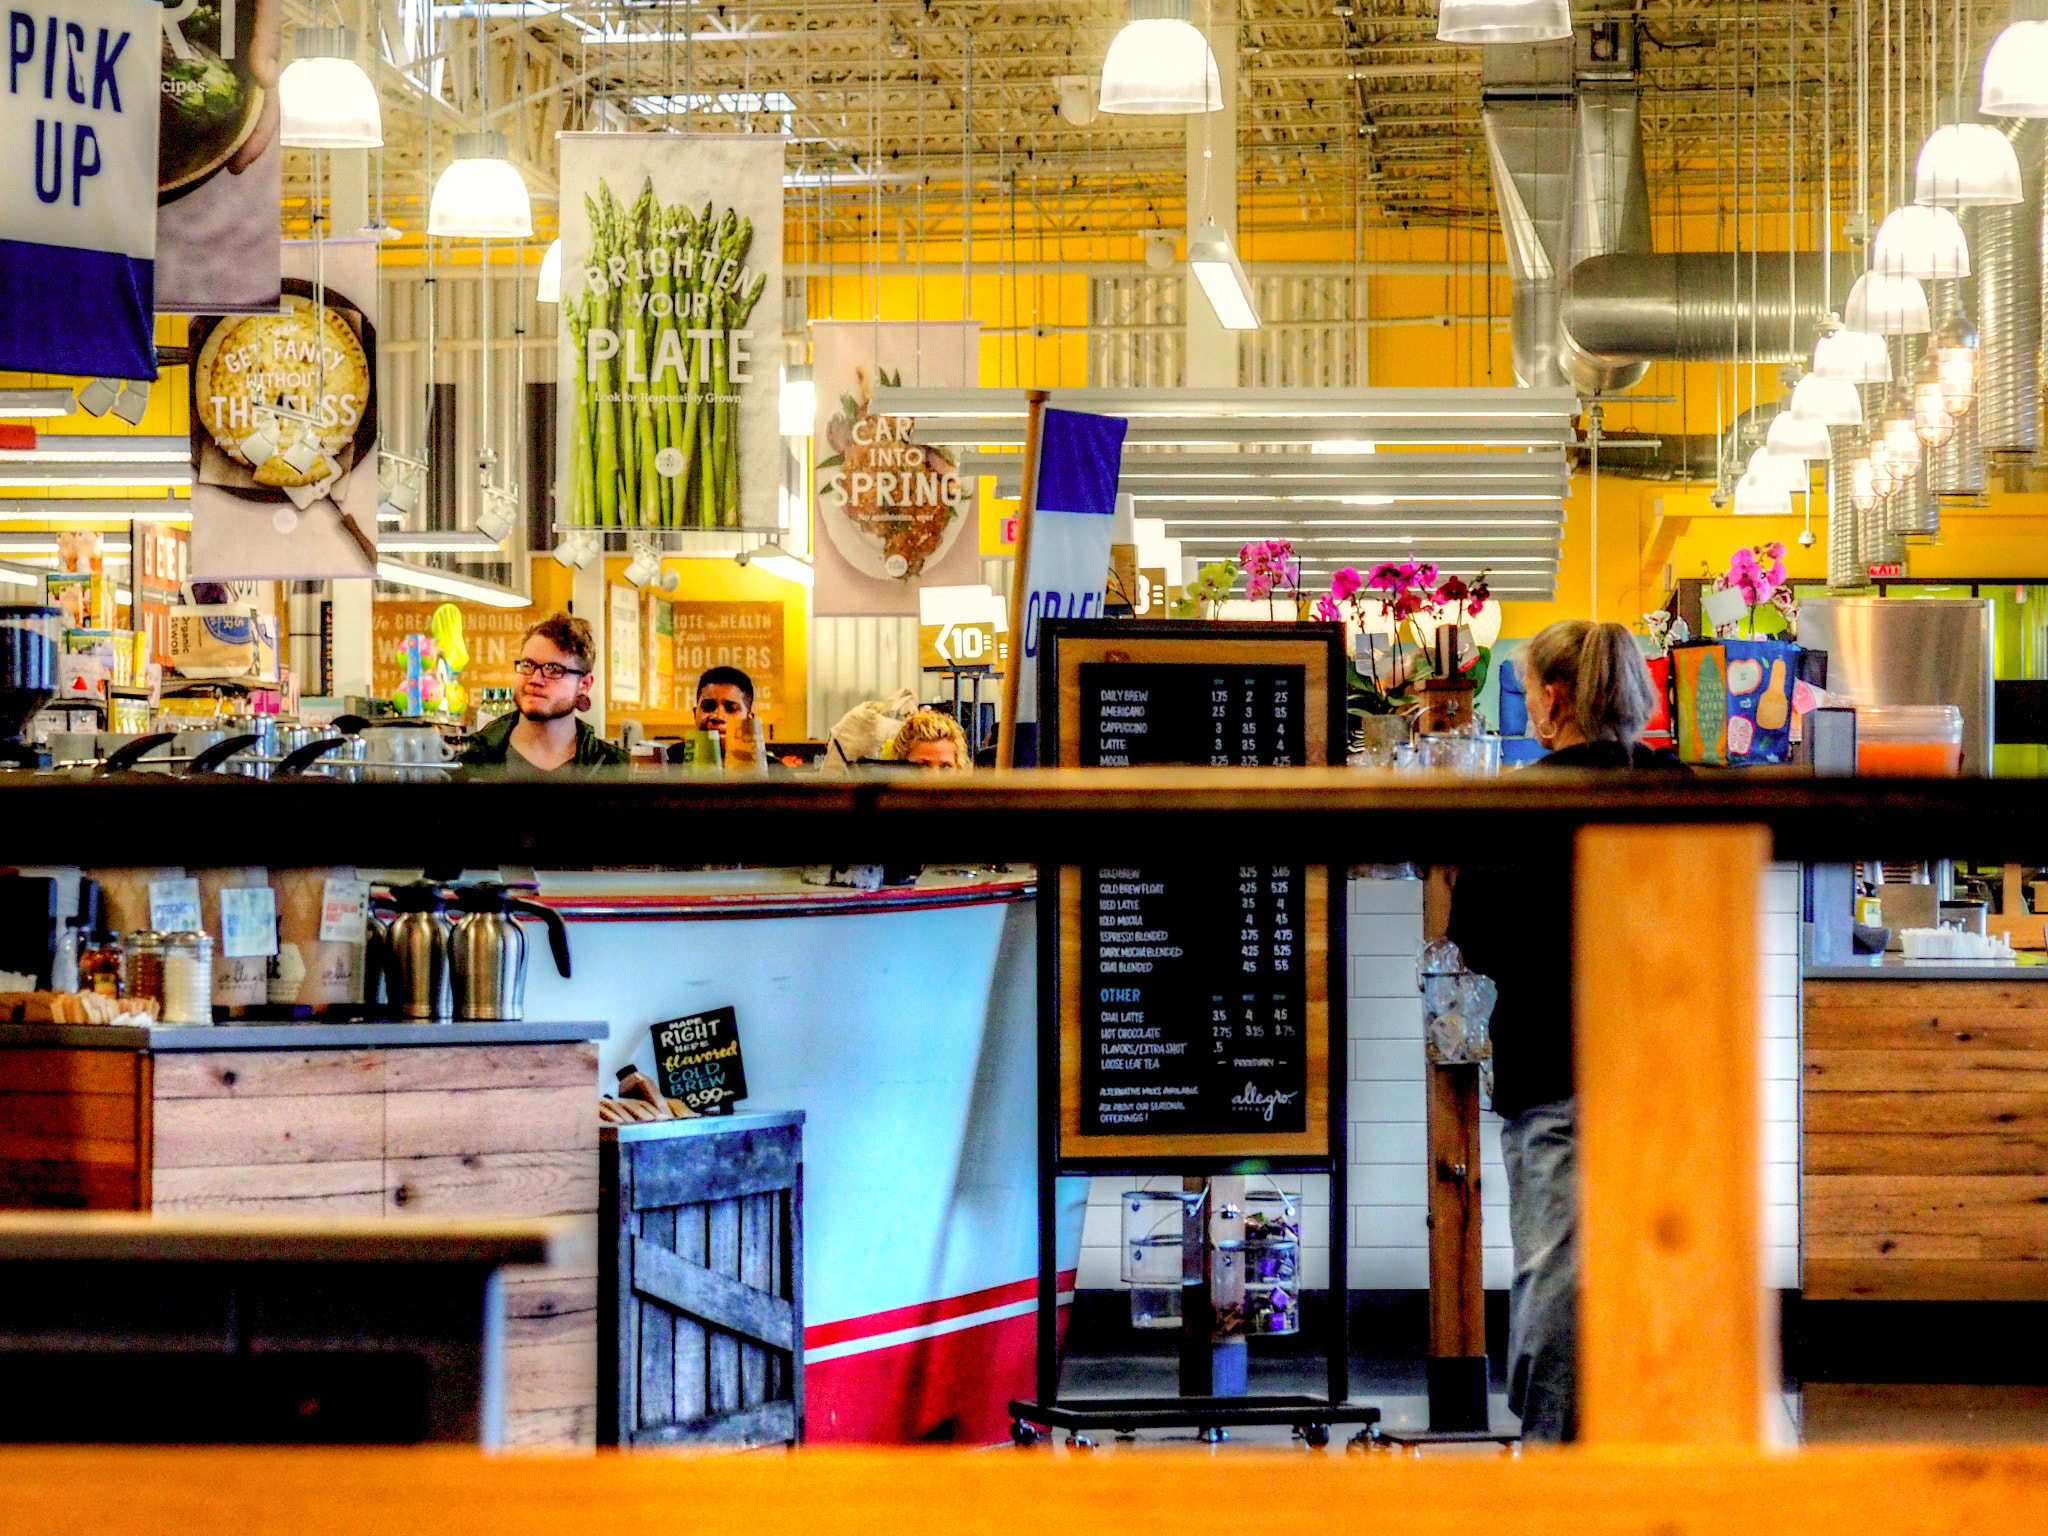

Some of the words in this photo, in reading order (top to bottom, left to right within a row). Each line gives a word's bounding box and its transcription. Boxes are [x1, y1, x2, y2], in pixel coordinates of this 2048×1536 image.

[10, 10, 130, 113] PICK
[161, 77, 210, 97] cipes.
[35, 119, 101, 206] UP
[584, 247, 757, 298] BRIGHTEN
[636, 292, 709, 319] YOUR
[224, 341, 262, 374] GET
[273, 338, 346, 371] FANCY
[587, 328, 754, 384] PLATE
[595, 392, 621, 403] Look
[623, 391, 638, 402] for
[640, 392, 703, 404] Responsibly
[210, 396, 266, 429] THE
[851, 417, 914, 446] CAR
[869, 448, 924, 467] INTO
[829, 471, 962, 508] SPRING
[395, 613, 434, 631] CREA
[720, 614, 772, 630] HEALTH
[1245, 690, 1253, 702] 2
[1101, 706, 1145, 717] AMERICANO
[1245, 706, 1253, 718] 3
[1215, 722, 1222, 734] 3
[1276, 723, 1285, 735] 4
[1101, 738, 1127, 750] LATTE
[1215, 738, 1222, 750] 3
[1276, 739, 1285, 751] 4
[1117, 899, 1140, 910] LATTE
[1276, 898, 1285, 910] 4
[1245, 913, 1253, 926] 4
[1101, 988, 1141, 1002] OTHER
[1120, 1011, 1144, 1023] LATTE
[1245, 1008, 1254, 1021] 4
[660, 1019, 721, 1048] RIGHT
[1101, 1027, 1117, 1039] HOT
[1117, 1027, 1161, 1039] CHOCOLATE
[662, 1040, 738, 1073] flavored
[1101, 1058, 1124, 1070] LOOSE
[1125, 1058, 1142, 1070] LEAF
[1143, 1059, 1160, 1070] TEA
[667, 1062, 721, 1085] COLD
[670, 1072, 726, 1097] BREW
